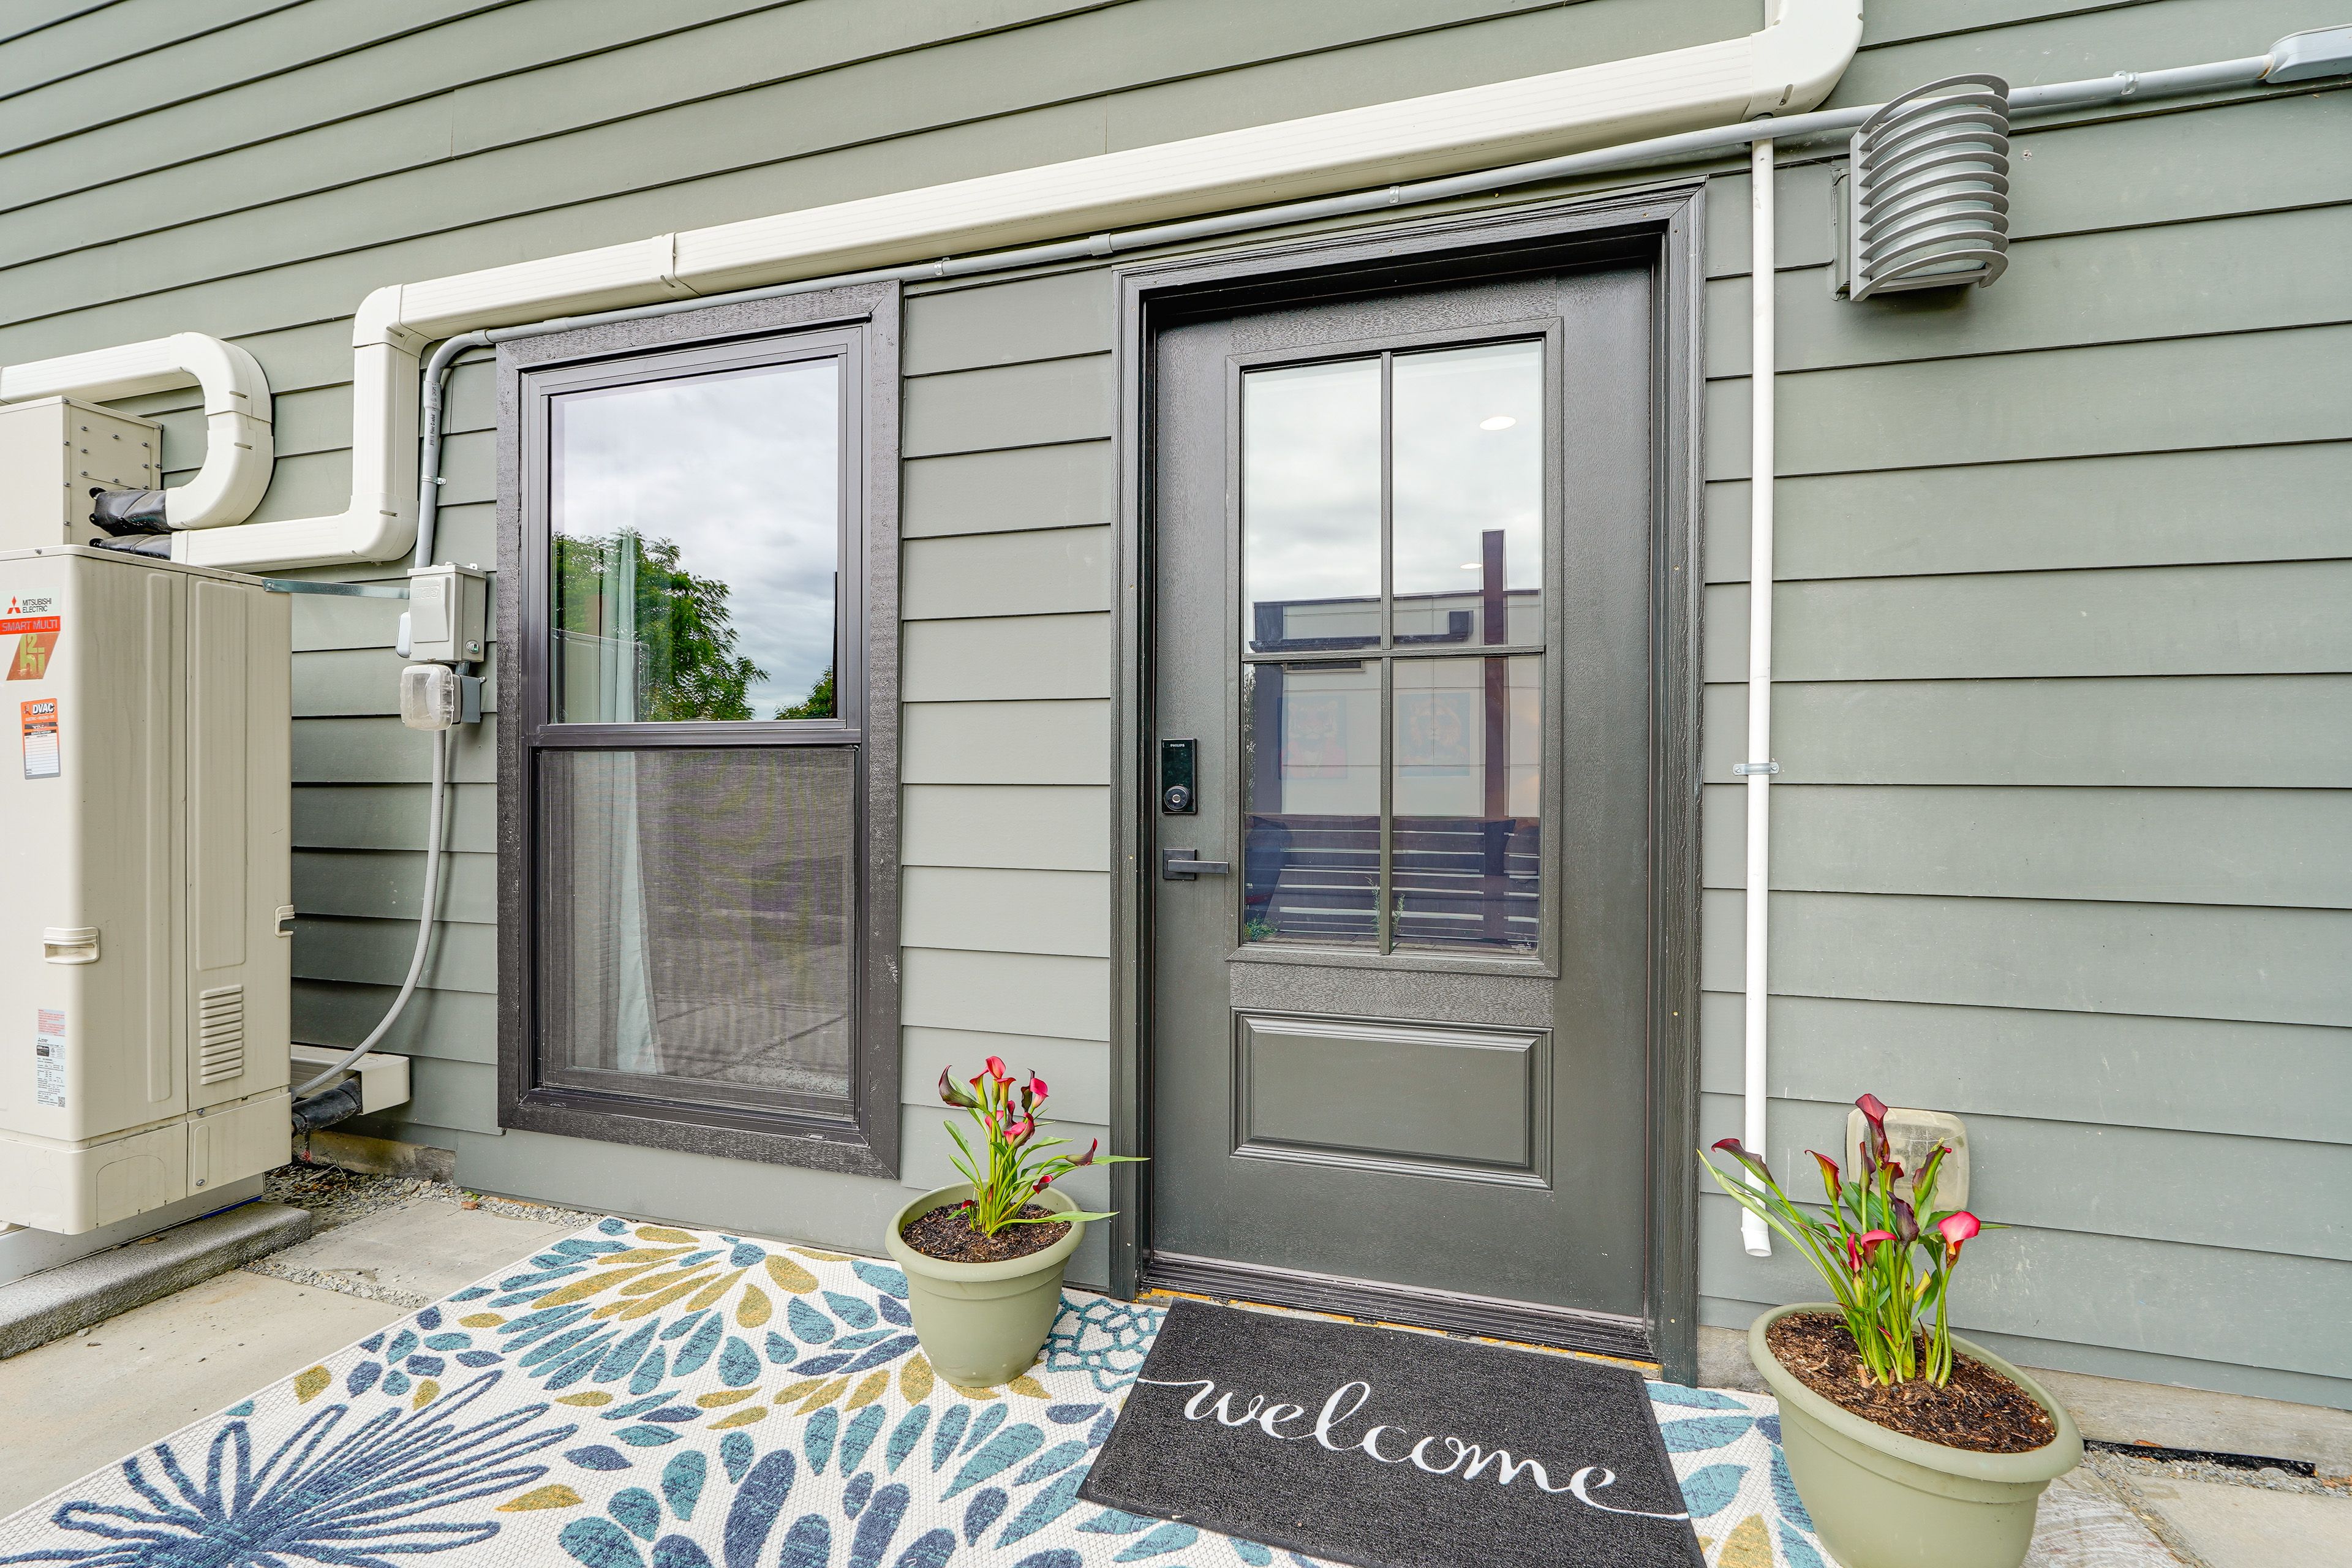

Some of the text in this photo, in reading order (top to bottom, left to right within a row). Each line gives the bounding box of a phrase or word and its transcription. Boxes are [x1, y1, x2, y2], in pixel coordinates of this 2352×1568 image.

[2, 619, 58, 631] SMART MULTI
[32, 703, 55, 715] DVAC
[1137, 1378, 1689, 1520] welcome
